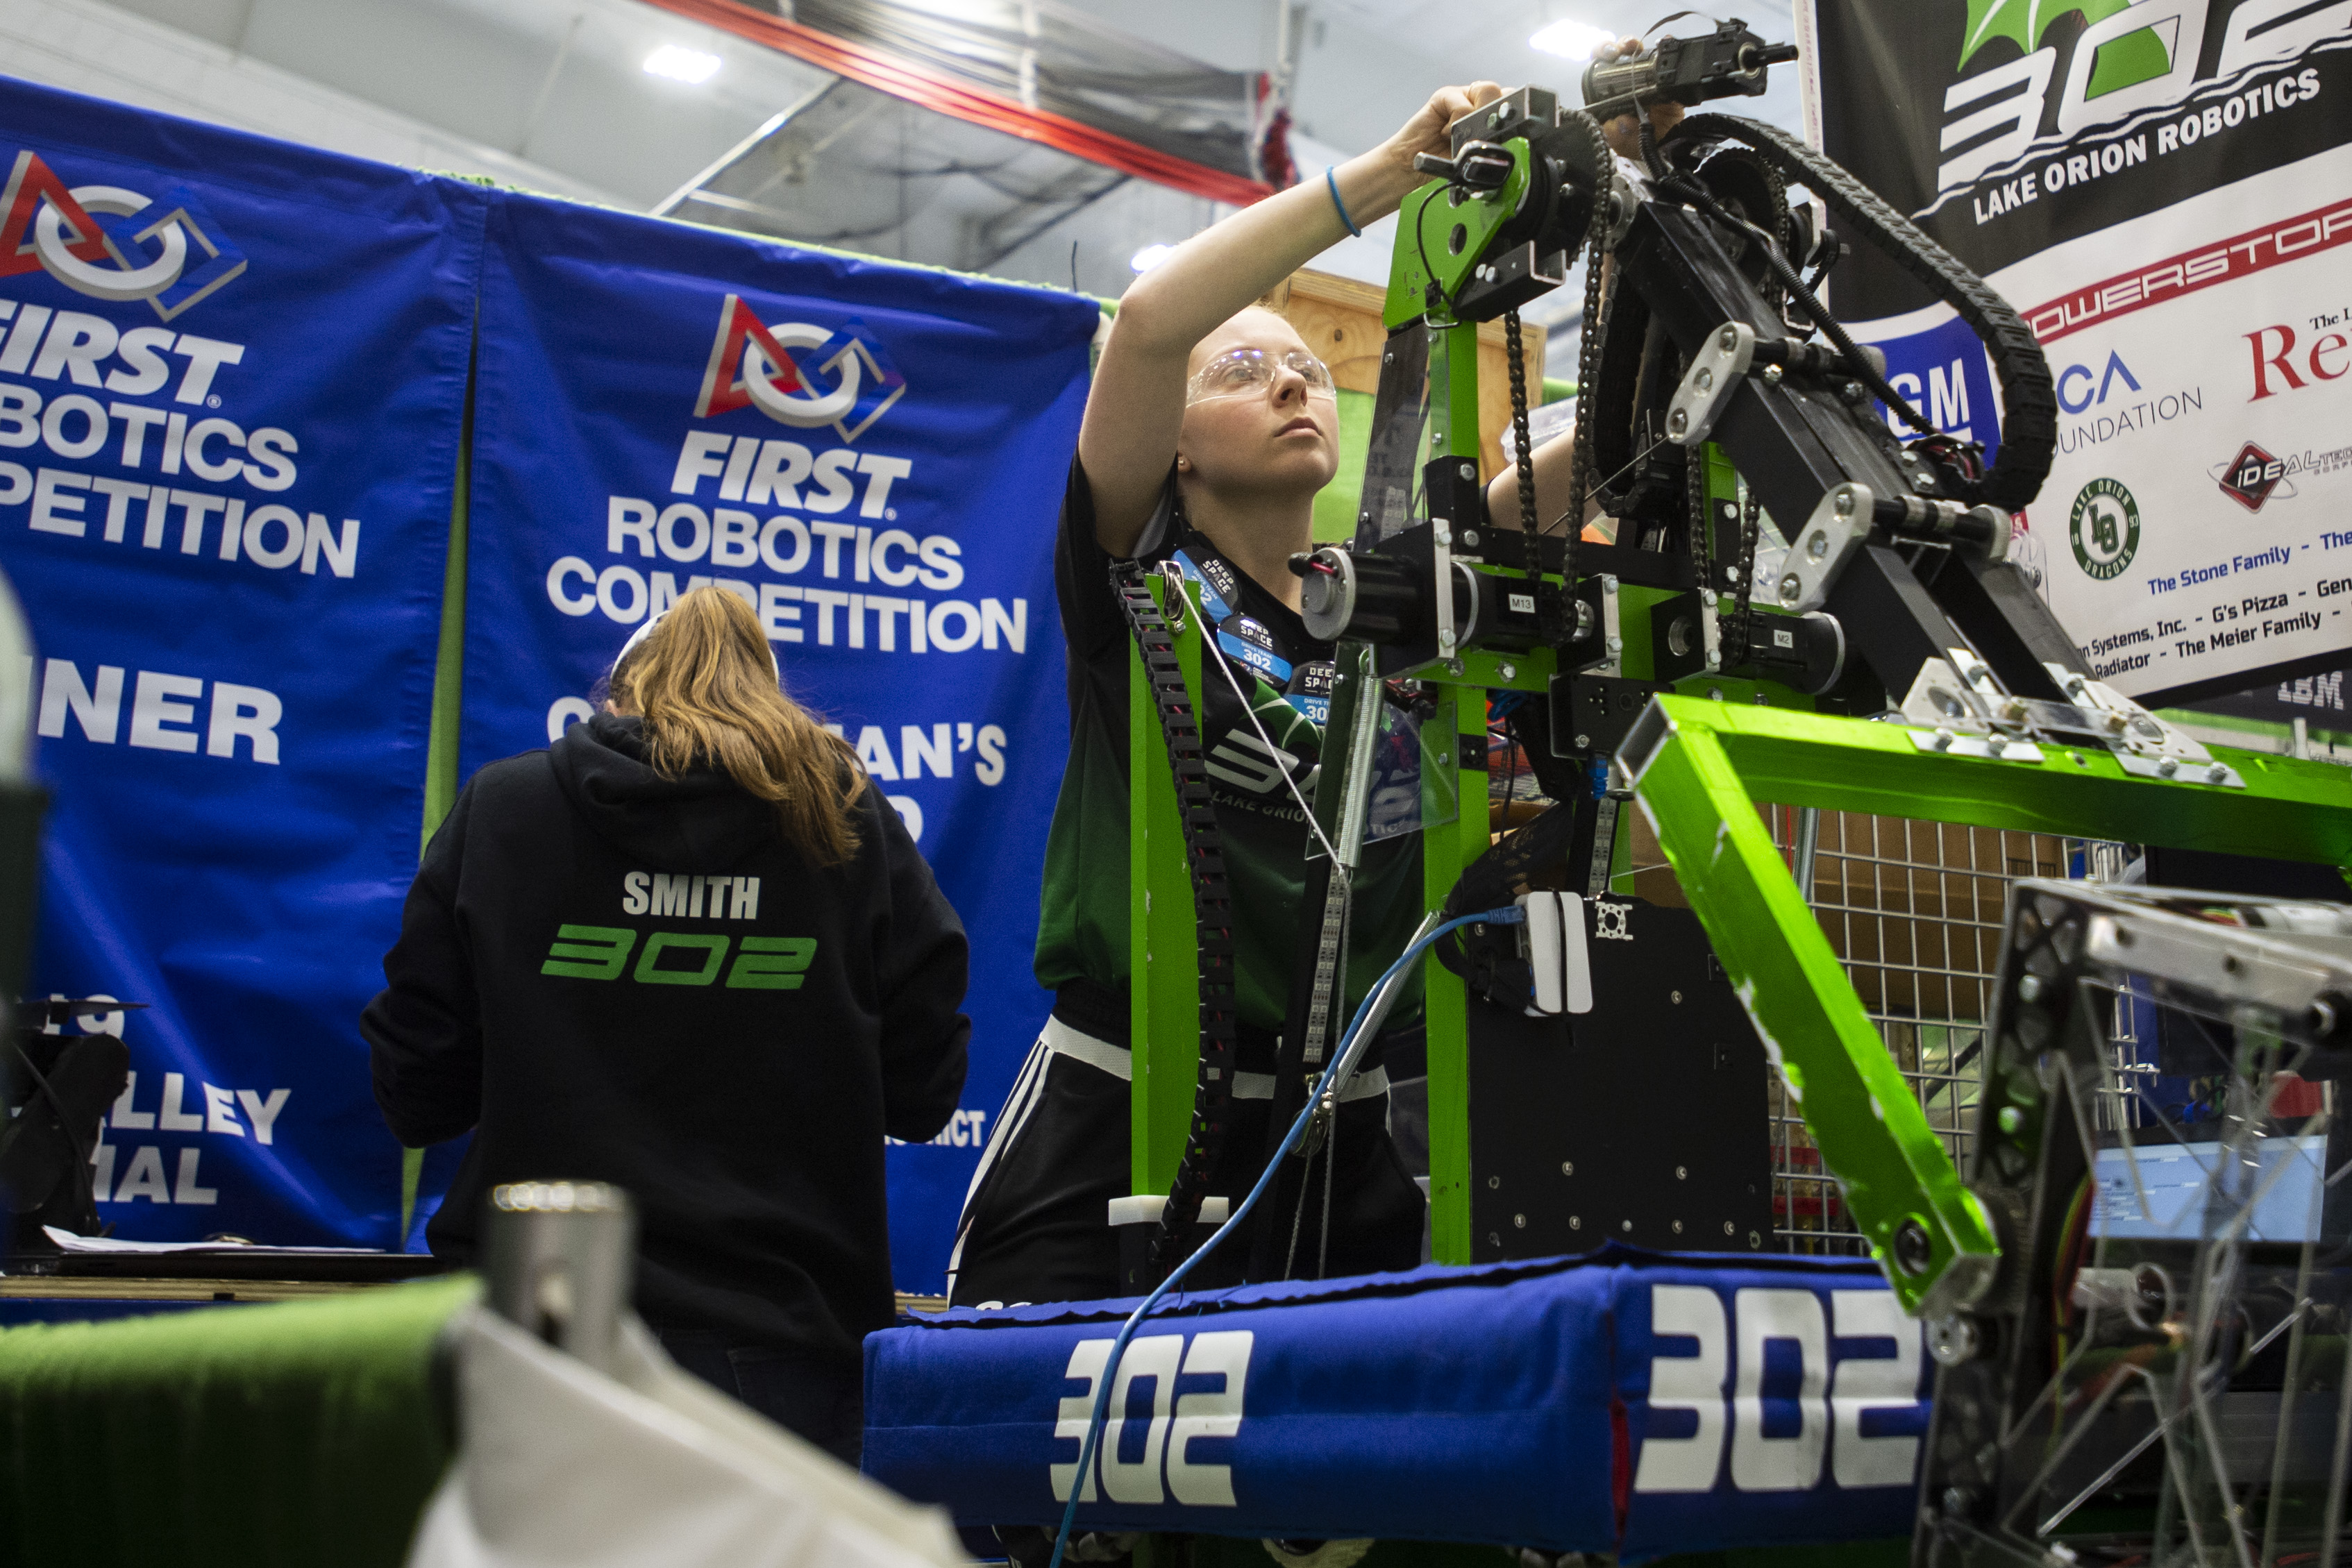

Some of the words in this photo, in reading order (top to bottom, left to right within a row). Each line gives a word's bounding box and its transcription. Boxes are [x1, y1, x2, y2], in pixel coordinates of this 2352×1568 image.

[1974, 174, 2038, 226] LAKE
[2044, 135, 2148, 194] ORION
[2157, 68, 2321, 155] ROBOTICS
[2309, 314, 2340, 331] The
[0, 297, 246, 406] IRST
[1886, 357, 1970, 438] GM
[2053, 386, 2202, 460] UNDATION
[2072, 485, 2093, 521] LAKE
[2097, 479, 2131, 507] ORION
[2128, 514, 2139, 528] 93
[607, 495, 964, 591] ROBOTICS
[2084, 547, 2133, 580] DRAGONS
[2147, 578, 2177, 596] The
[2180, 563, 2228, 587] Stone
[2233, 546, 2291, 574] Family
[2319, 530, 2352, 550] The
[1212, 559, 1234, 584] DEEP
[1512, 598, 1531, 609] M13
[2092, 627, 2154, 657] Systems,
[2156, 619, 2187, 637] Inc.
[2212, 605, 2238, 623] G's
[2242, 593, 2289, 616] Pizza
[1243, 648, 1271, 671] 302
[1777, 634, 1790, 645] M2
[2094, 652, 2151, 680] Radiator
[2175, 639, 2206, 658] The
[2210, 626, 2258, 650] Meier
[2262, 611, 2321, 638] Family
[1309, 667, 1334, 678] DEE
[1304, 698, 1323, 706] DRIVE
[1305, 705, 1329, 721] 30
[1211, 790, 1255, 811] LAKE
[623, 871, 760, 920] SMITH
[540, 924, 818, 990] 302
[102, 1070, 292, 1145] LLEY
[1633, 1283, 1923, 1494] 302
[1050, 1330, 1254, 1508] 302
